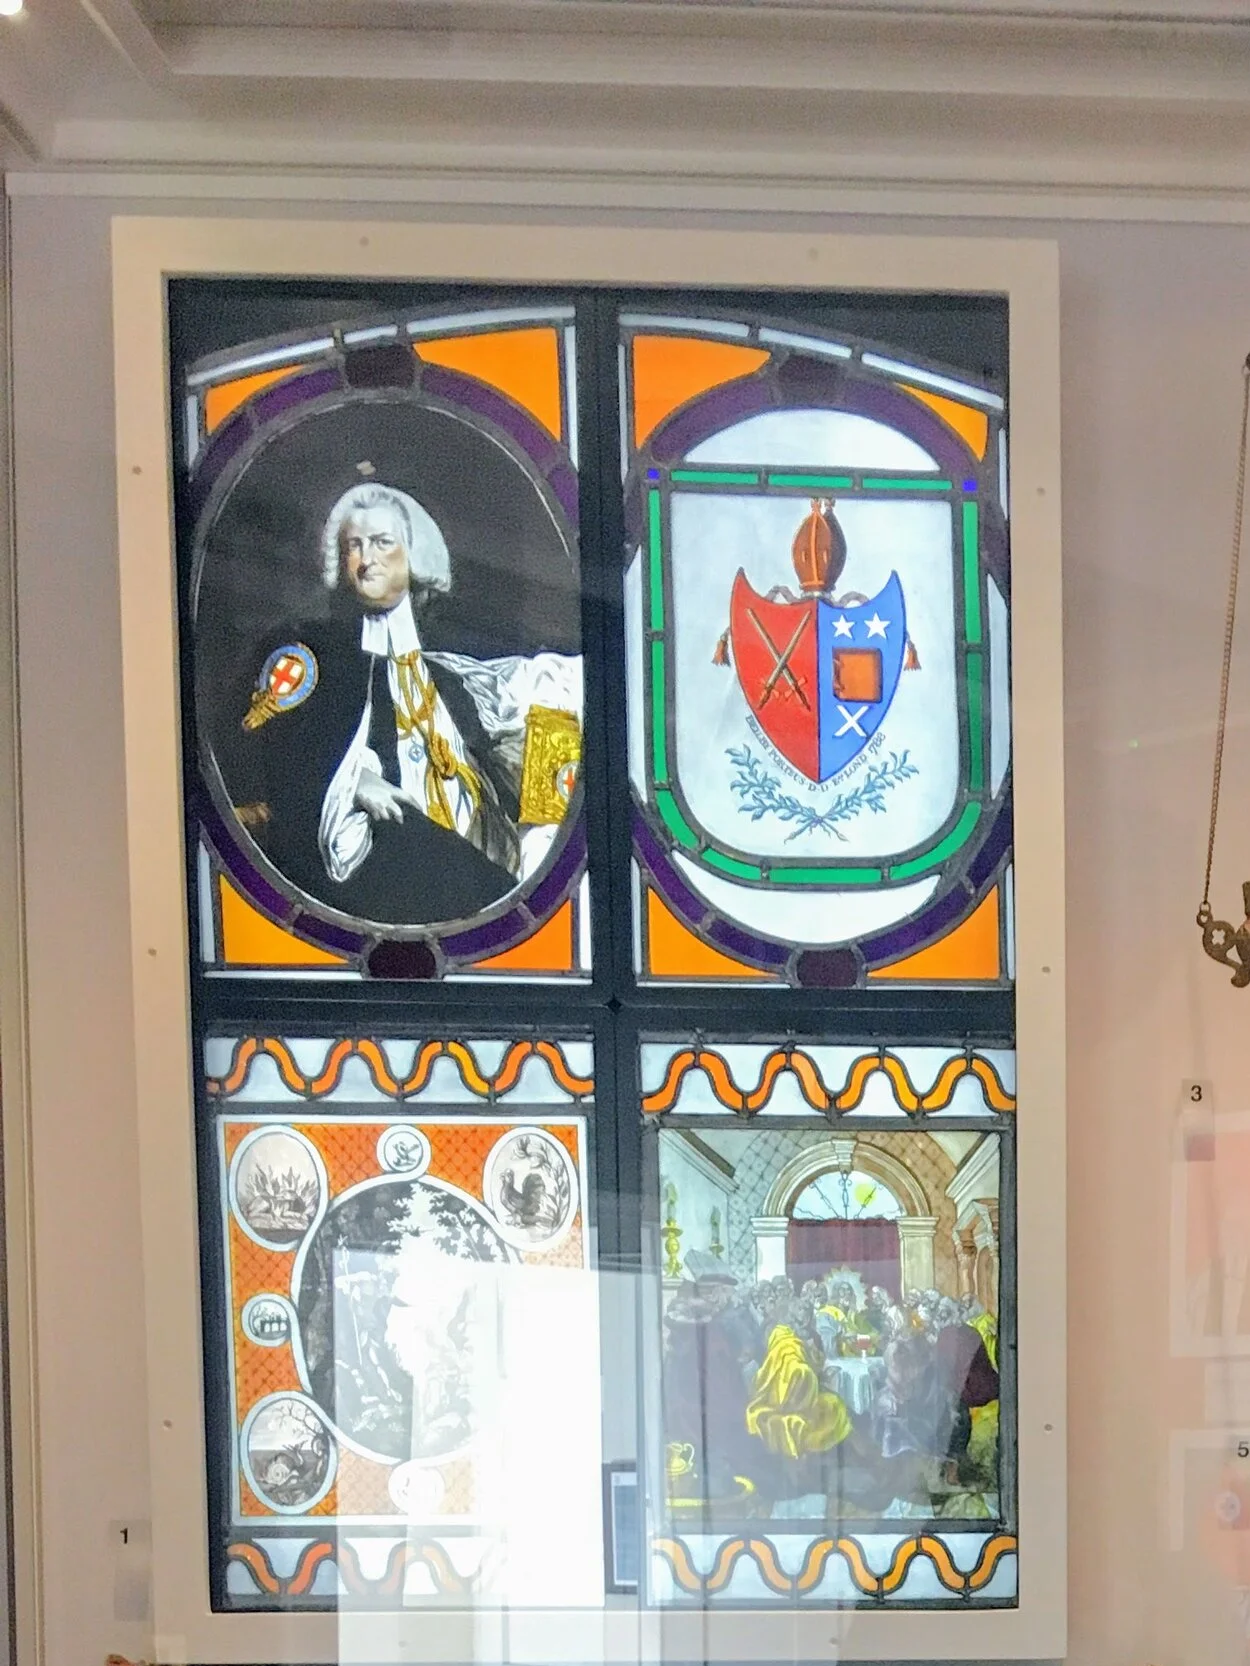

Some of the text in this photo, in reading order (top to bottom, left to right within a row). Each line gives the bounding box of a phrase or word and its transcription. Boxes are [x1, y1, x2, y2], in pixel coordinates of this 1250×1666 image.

[1191, 1084, 1202, 1101] 3
[1238, 1440, 1249, 1458] 5
[120, 1527, 128, 1545] 1
